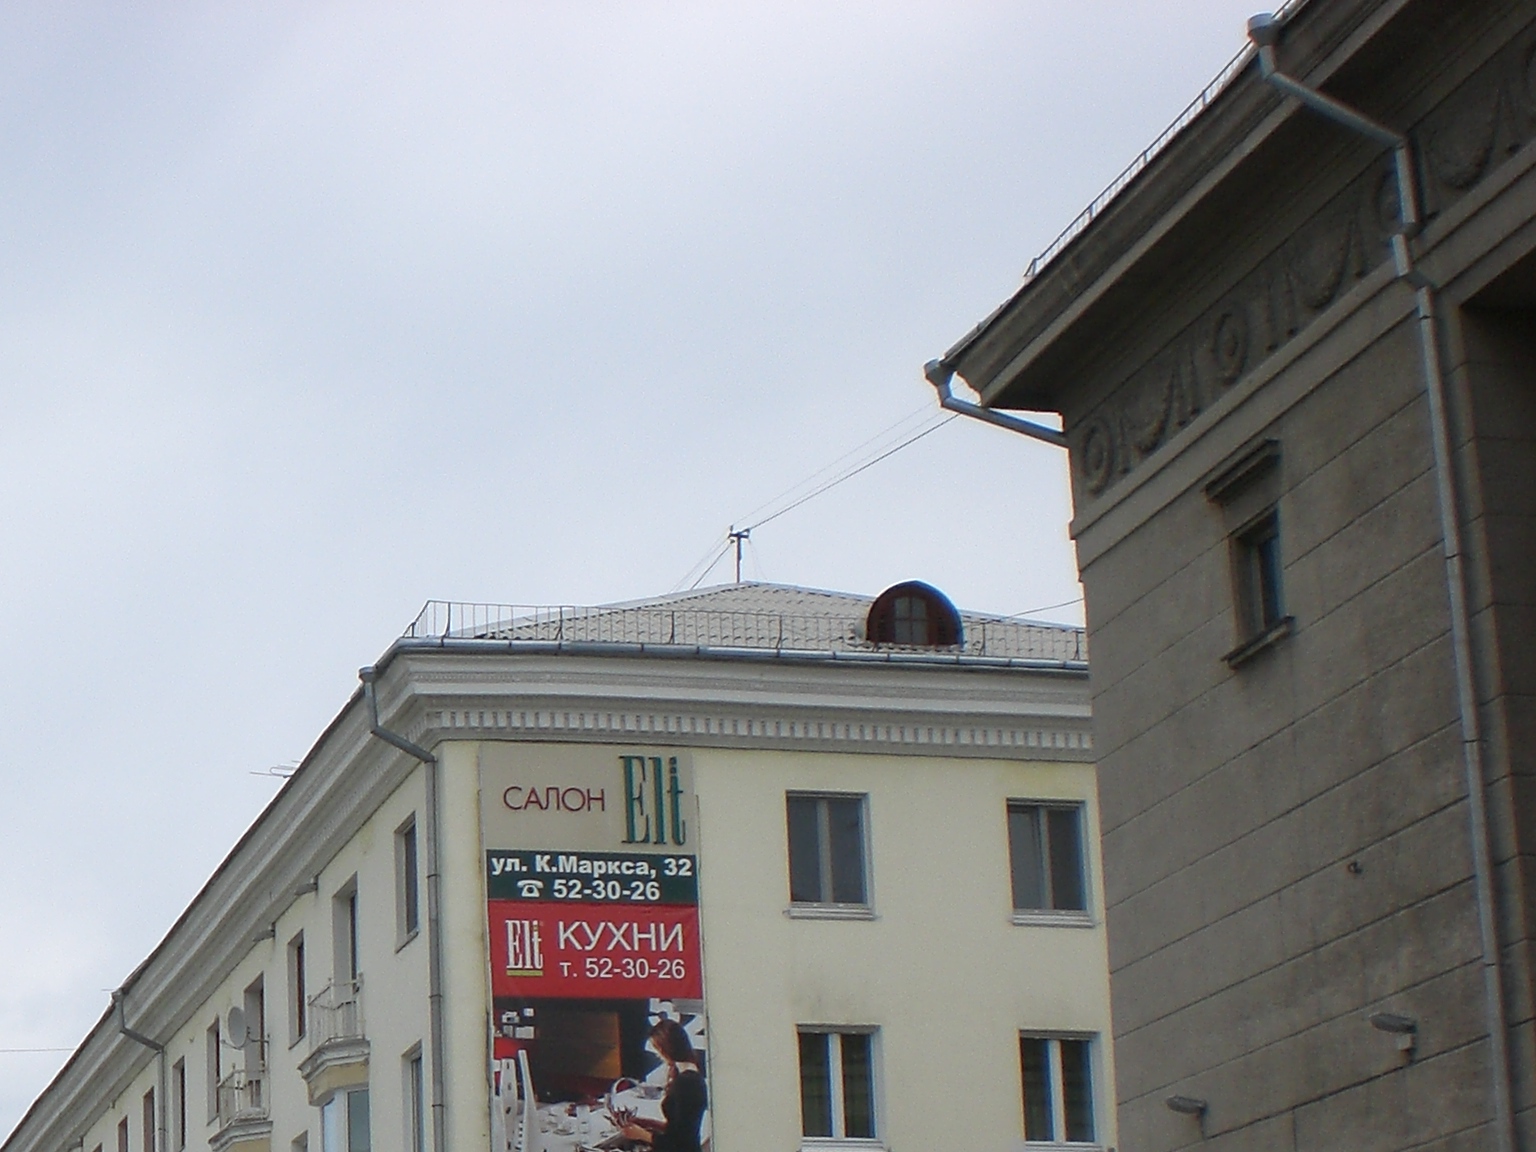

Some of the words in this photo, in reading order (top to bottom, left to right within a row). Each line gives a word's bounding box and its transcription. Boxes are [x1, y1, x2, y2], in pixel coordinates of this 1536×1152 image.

[503, 786, 605, 812] САЛОН
[491, 857, 527, 875] ул.
[535, 854, 657, 878] К.Маркса,
[664, 858, 692, 876] 32
[553, 879, 660, 900] 52-30-26
[558, 921, 684, 951] КУХНИ
[560, 962, 578, 977] т.
[585, 958, 685, 979] 52-30-26
